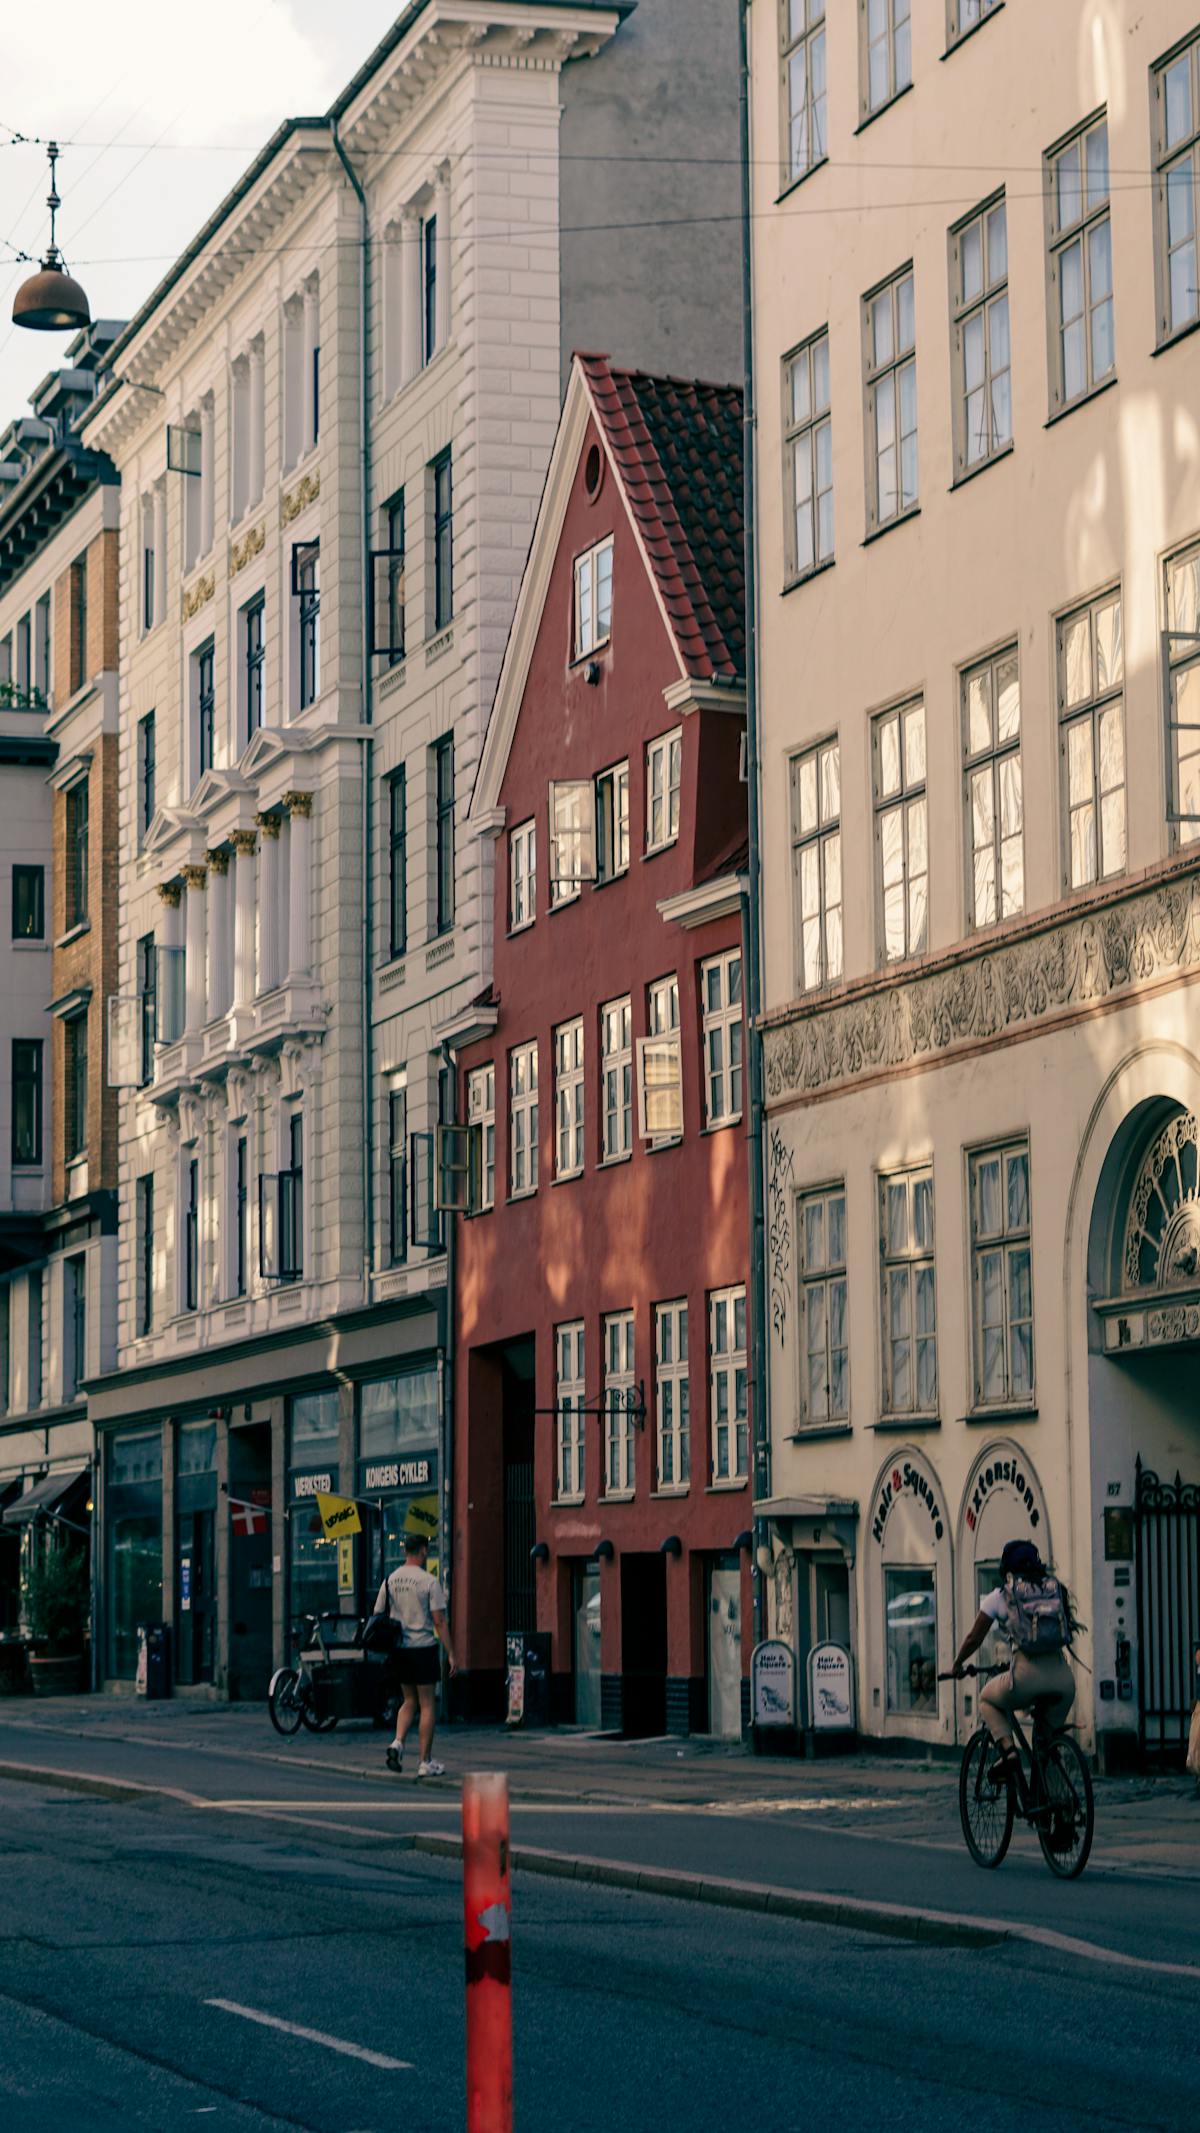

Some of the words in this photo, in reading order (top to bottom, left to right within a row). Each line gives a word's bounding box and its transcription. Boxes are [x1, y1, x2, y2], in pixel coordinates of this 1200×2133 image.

[366, 1465, 398, 1488] KONGENS
[400, 1461, 428, 1485] CYKLER
[872, 1482, 893, 1543] Hair
[892, 1469, 902, 1492] &
[903, 1463, 943, 1540] Square
[966, 1459, 1040, 1532] Extensions
